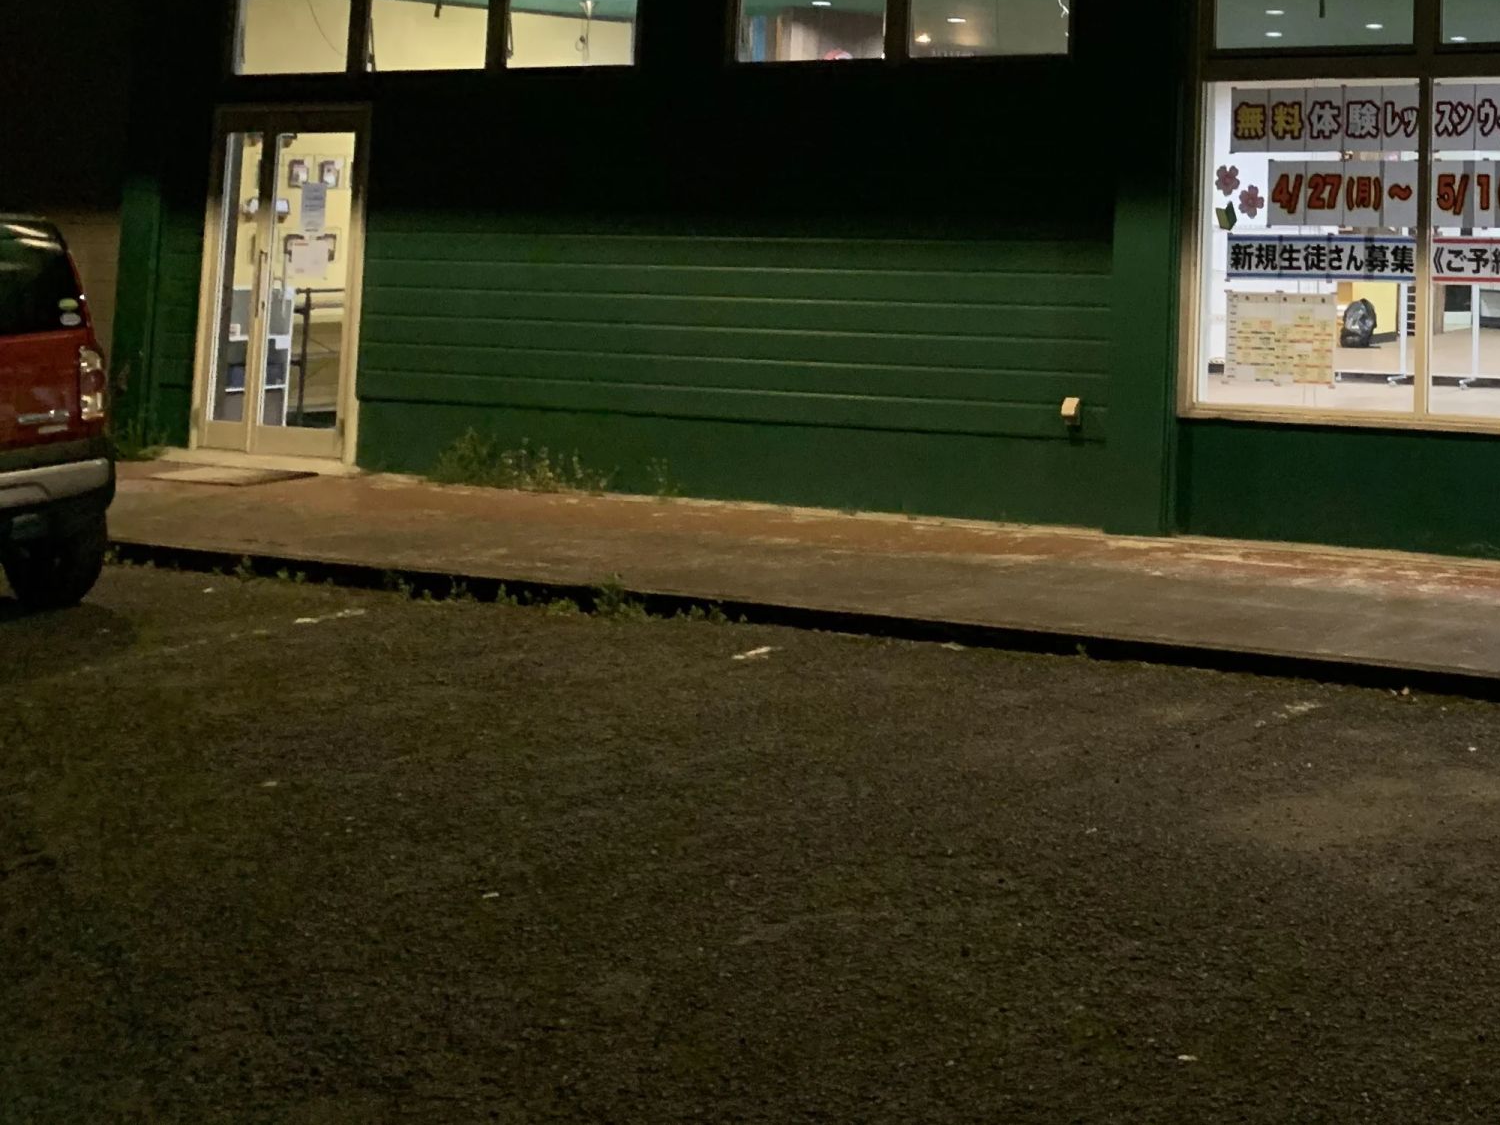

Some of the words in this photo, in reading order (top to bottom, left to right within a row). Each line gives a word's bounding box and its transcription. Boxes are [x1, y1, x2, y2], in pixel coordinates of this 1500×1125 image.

[1230, 242, 1414, 275] 新規生徒さん募集
